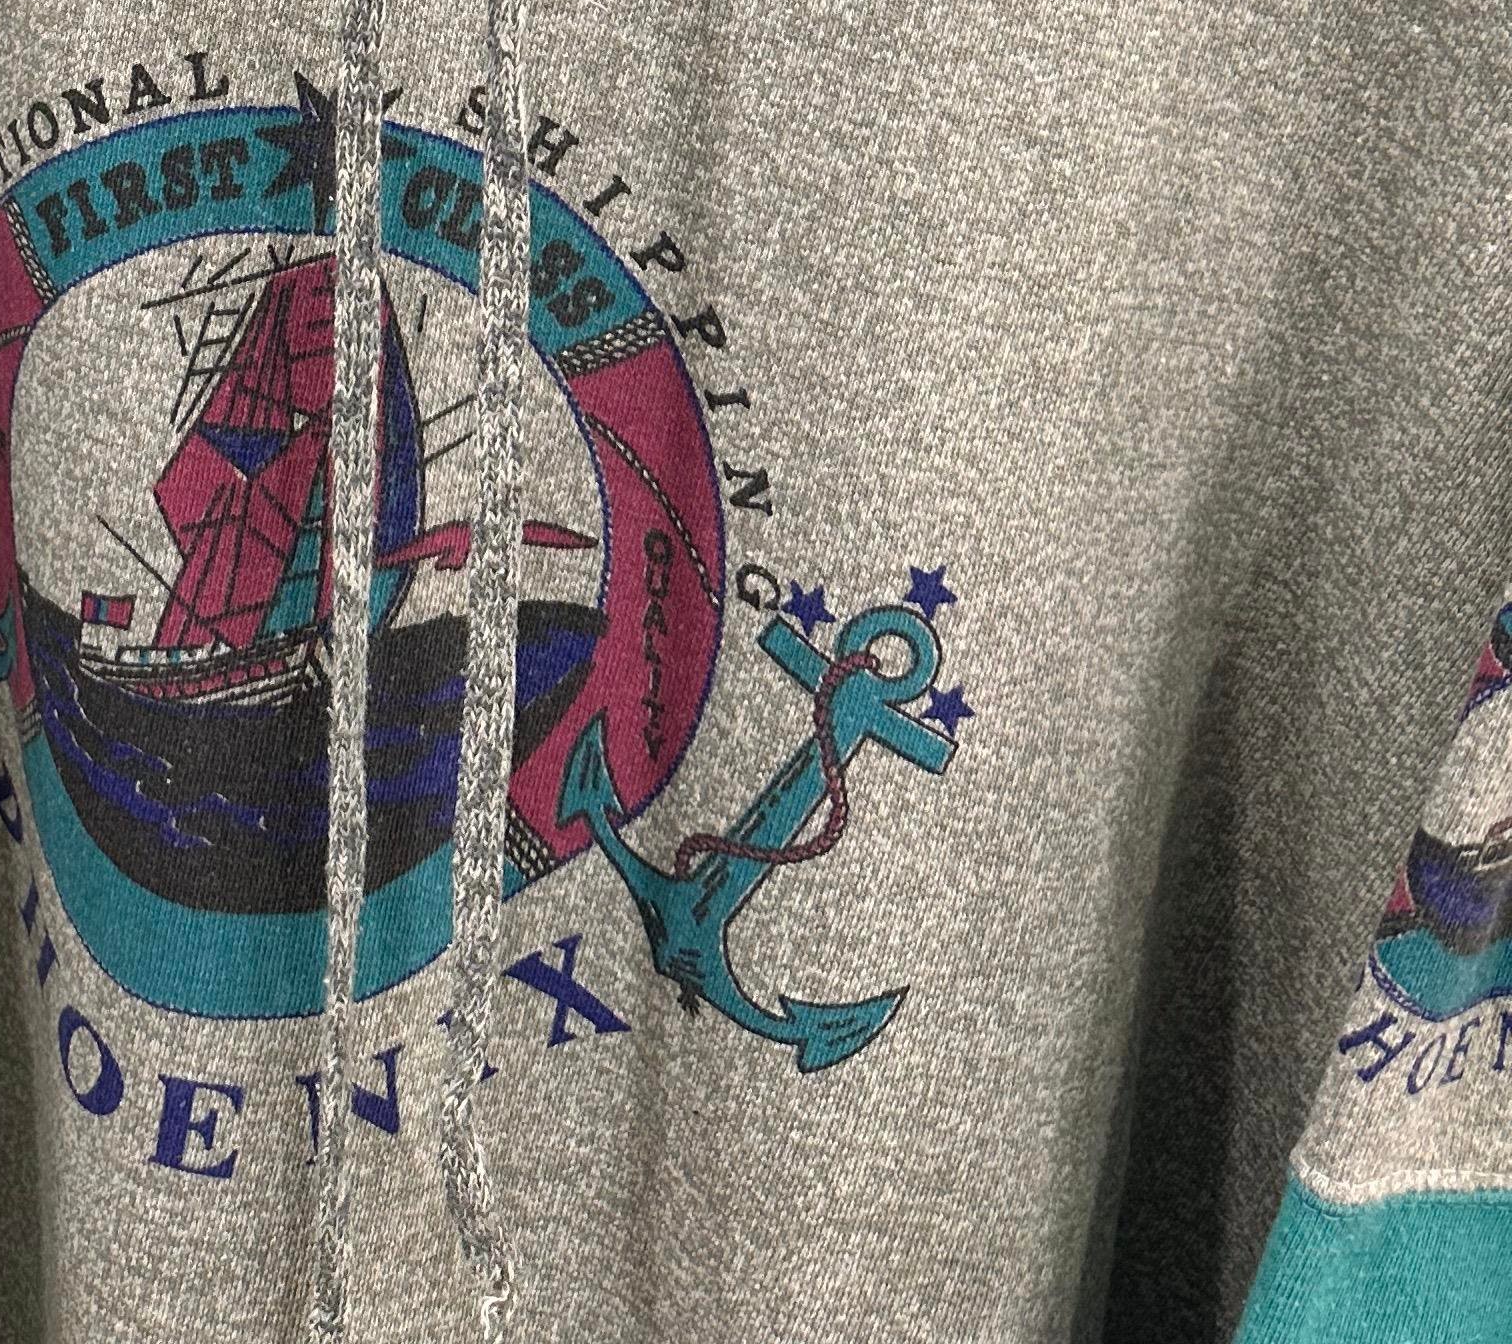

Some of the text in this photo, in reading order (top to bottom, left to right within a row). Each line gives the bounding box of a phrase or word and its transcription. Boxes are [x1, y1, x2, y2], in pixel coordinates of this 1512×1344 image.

[33, 135, 617, 329] FIRST CLSS
[641, 525, 675, 763] QUALITY
